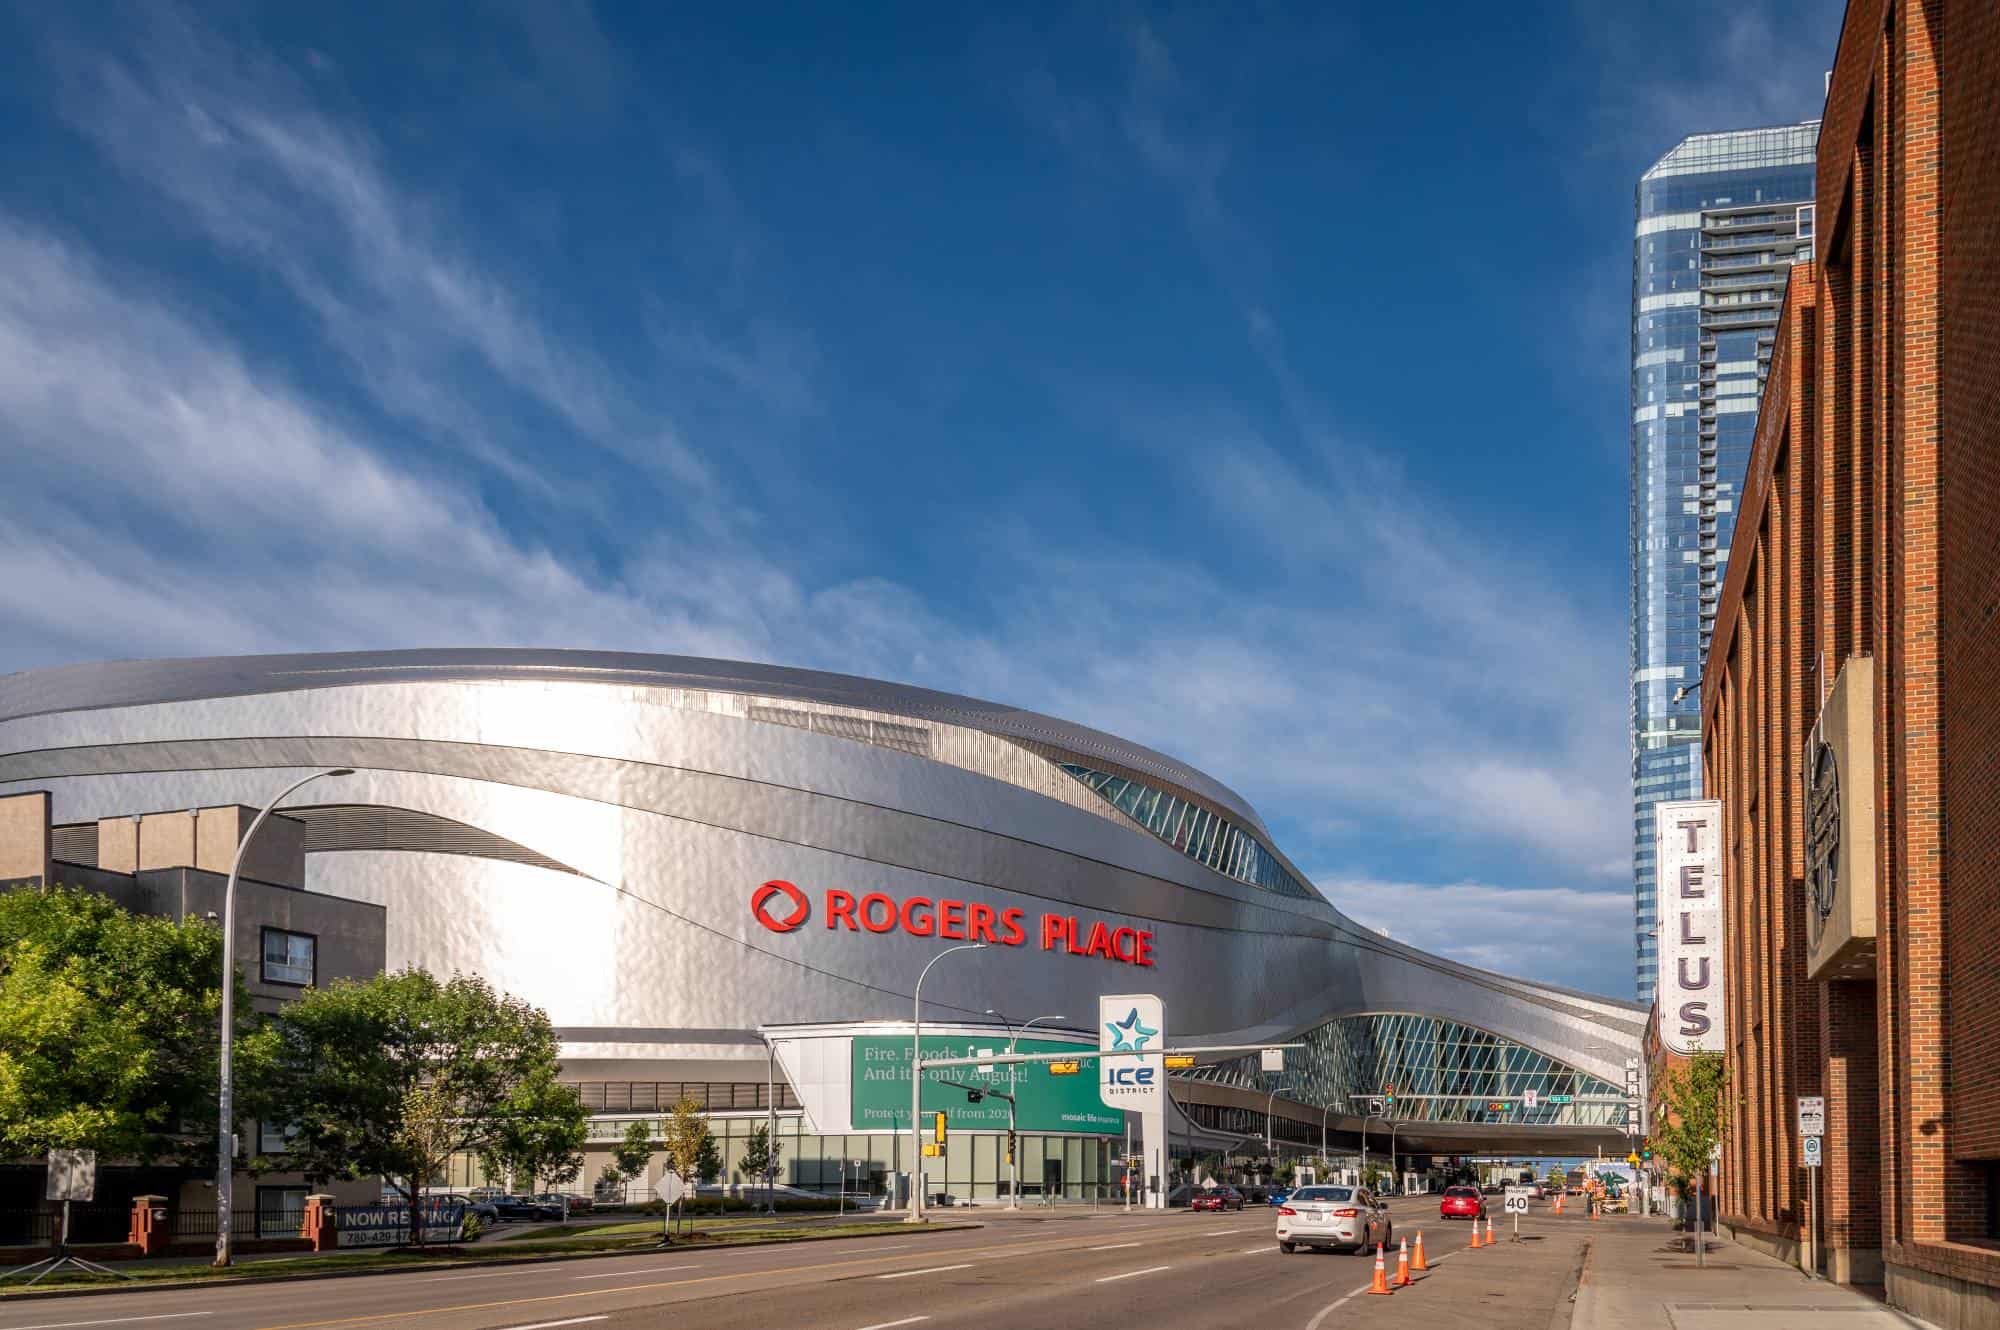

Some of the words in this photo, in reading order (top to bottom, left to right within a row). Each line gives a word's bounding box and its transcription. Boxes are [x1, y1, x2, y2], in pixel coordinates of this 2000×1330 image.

[825, 889, 1026, 945] ROGERS
[1040, 912, 1154, 967] PLACE
[1677, 819, 1712, 1036] TELUS
[864, 1048, 899, 1061] Fire.
[863, 1067, 895, 1081] And
[930, 1066, 965, 1084] only
[864, 1108, 904, 1119] Protect
[958, 1108, 985, 1119] from
[1507, 1197, 1527, 1209] 40
[345, 1212, 384, 1226] NOW
